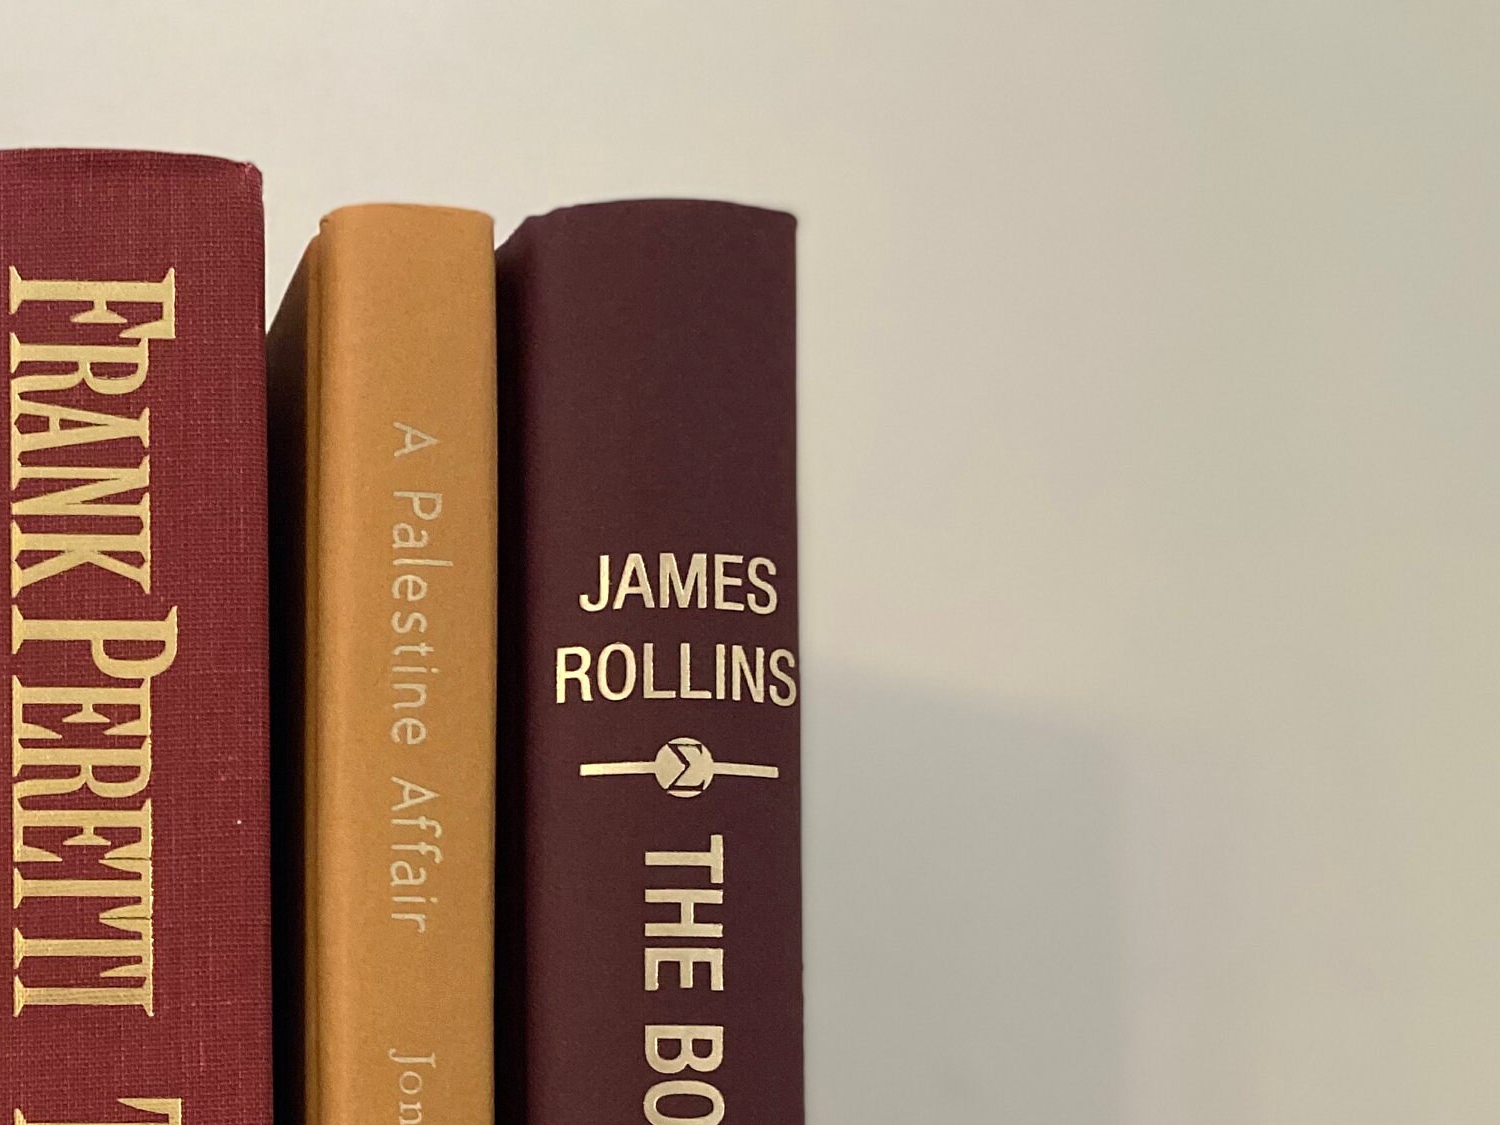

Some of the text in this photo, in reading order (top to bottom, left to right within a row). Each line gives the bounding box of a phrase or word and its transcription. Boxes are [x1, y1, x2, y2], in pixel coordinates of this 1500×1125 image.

[9, 266, 178, 1017] FRANK PERETTI
[579, 553, 777, 614] JAMES
[390, 422, 453, 932] A Palestine Affair
[556, 643, 797, 706] ROLLINS
[645, 834, 724, 991] THE
